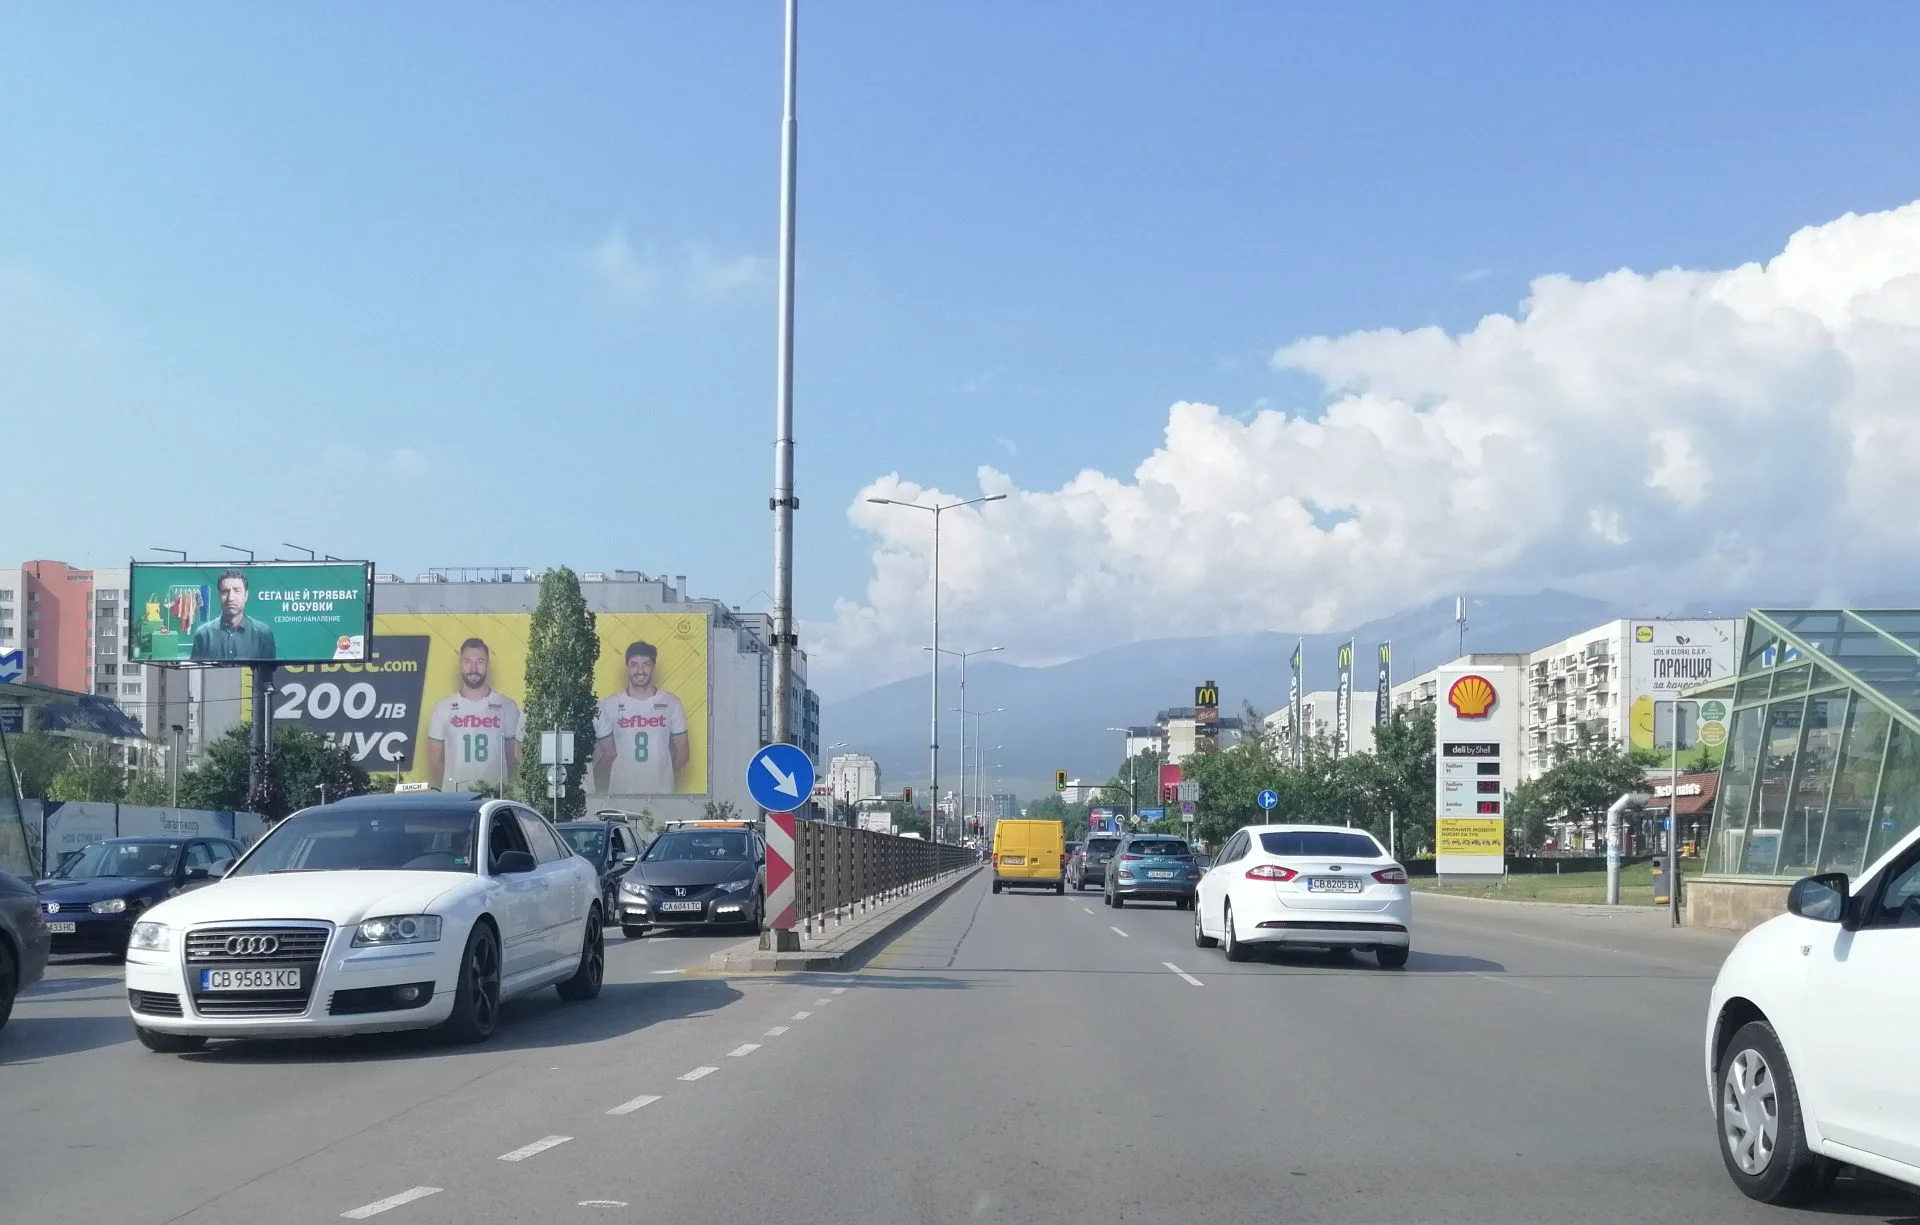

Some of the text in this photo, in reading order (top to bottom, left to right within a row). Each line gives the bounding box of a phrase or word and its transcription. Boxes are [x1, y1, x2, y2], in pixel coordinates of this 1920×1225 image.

[258, 589, 358, 602] СЕГА ЩЕ Й ТРЯБВАТ
[282, 602, 333, 612] И ОБУВКИ
[1653, 658, 1712, 680] ГАРАНЦИЯ
[273, 682, 377, 719] 200
[451, 715, 500, 728] efbet
[619, 715, 667, 728] efbet
[463, 734, 488, 763] 18
[635, 732, 648, 762] 8
[1467, 746, 1475, 755] by
[1314, 880, 1359, 889] CB 8205 BX
[212, 970, 297, 987] CB 9583 KC
